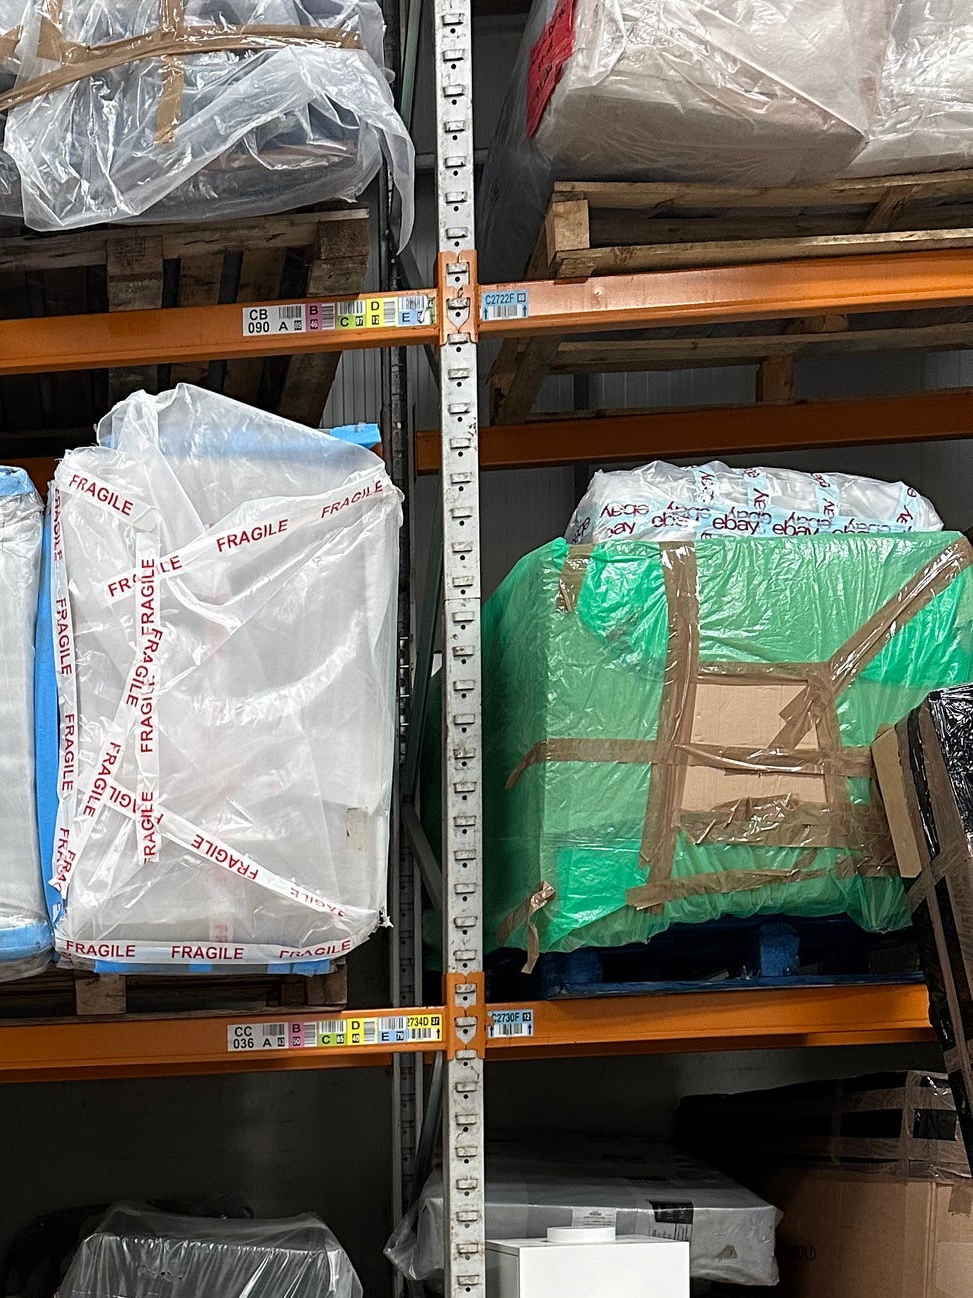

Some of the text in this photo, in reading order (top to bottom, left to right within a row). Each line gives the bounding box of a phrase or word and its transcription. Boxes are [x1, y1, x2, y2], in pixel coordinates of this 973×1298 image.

[485, 293, 515, 305] C2722F
[310, 306, 318, 315] B
[371, 301, 380, 311] D
[249, 309, 268, 320] CB
[402, 313, 410, 322] E
[248, 321, 270, 334] 090
[278, 321, 288, 331] A
[340, 317, 349, 327] C
[68, 474, 134, 516] FRAGILE
[216, 519, 289, 552] FRAGILE
[321, 480, 384, 518] FRAGILE
[713, 514, 760, 535] ebay
[56, 598, 72, 675] FRAGILE
[126, 628, 163, 707] FRAGILE
[61, 713, 75, 791] FRAGILE
[83, 742, 122, 817] FRAGILE
[191, 834, 259, 881] FRAGILE
[65, 940, 351, 960] FRAGILE FRAGILE FRAGILE
[352, 1021, 360, 1030] D
[407, 1017, 429, 1027] 2734D
[234, 1026, 253, 1037] CC
[292, 1024, 301, 1033] B
[322, 1035, 330, 1044] C
[381, 1032, 389, 1041] E
[233, 1038, 255, 1049] 036
[263, 1038, 272, 1047] A
